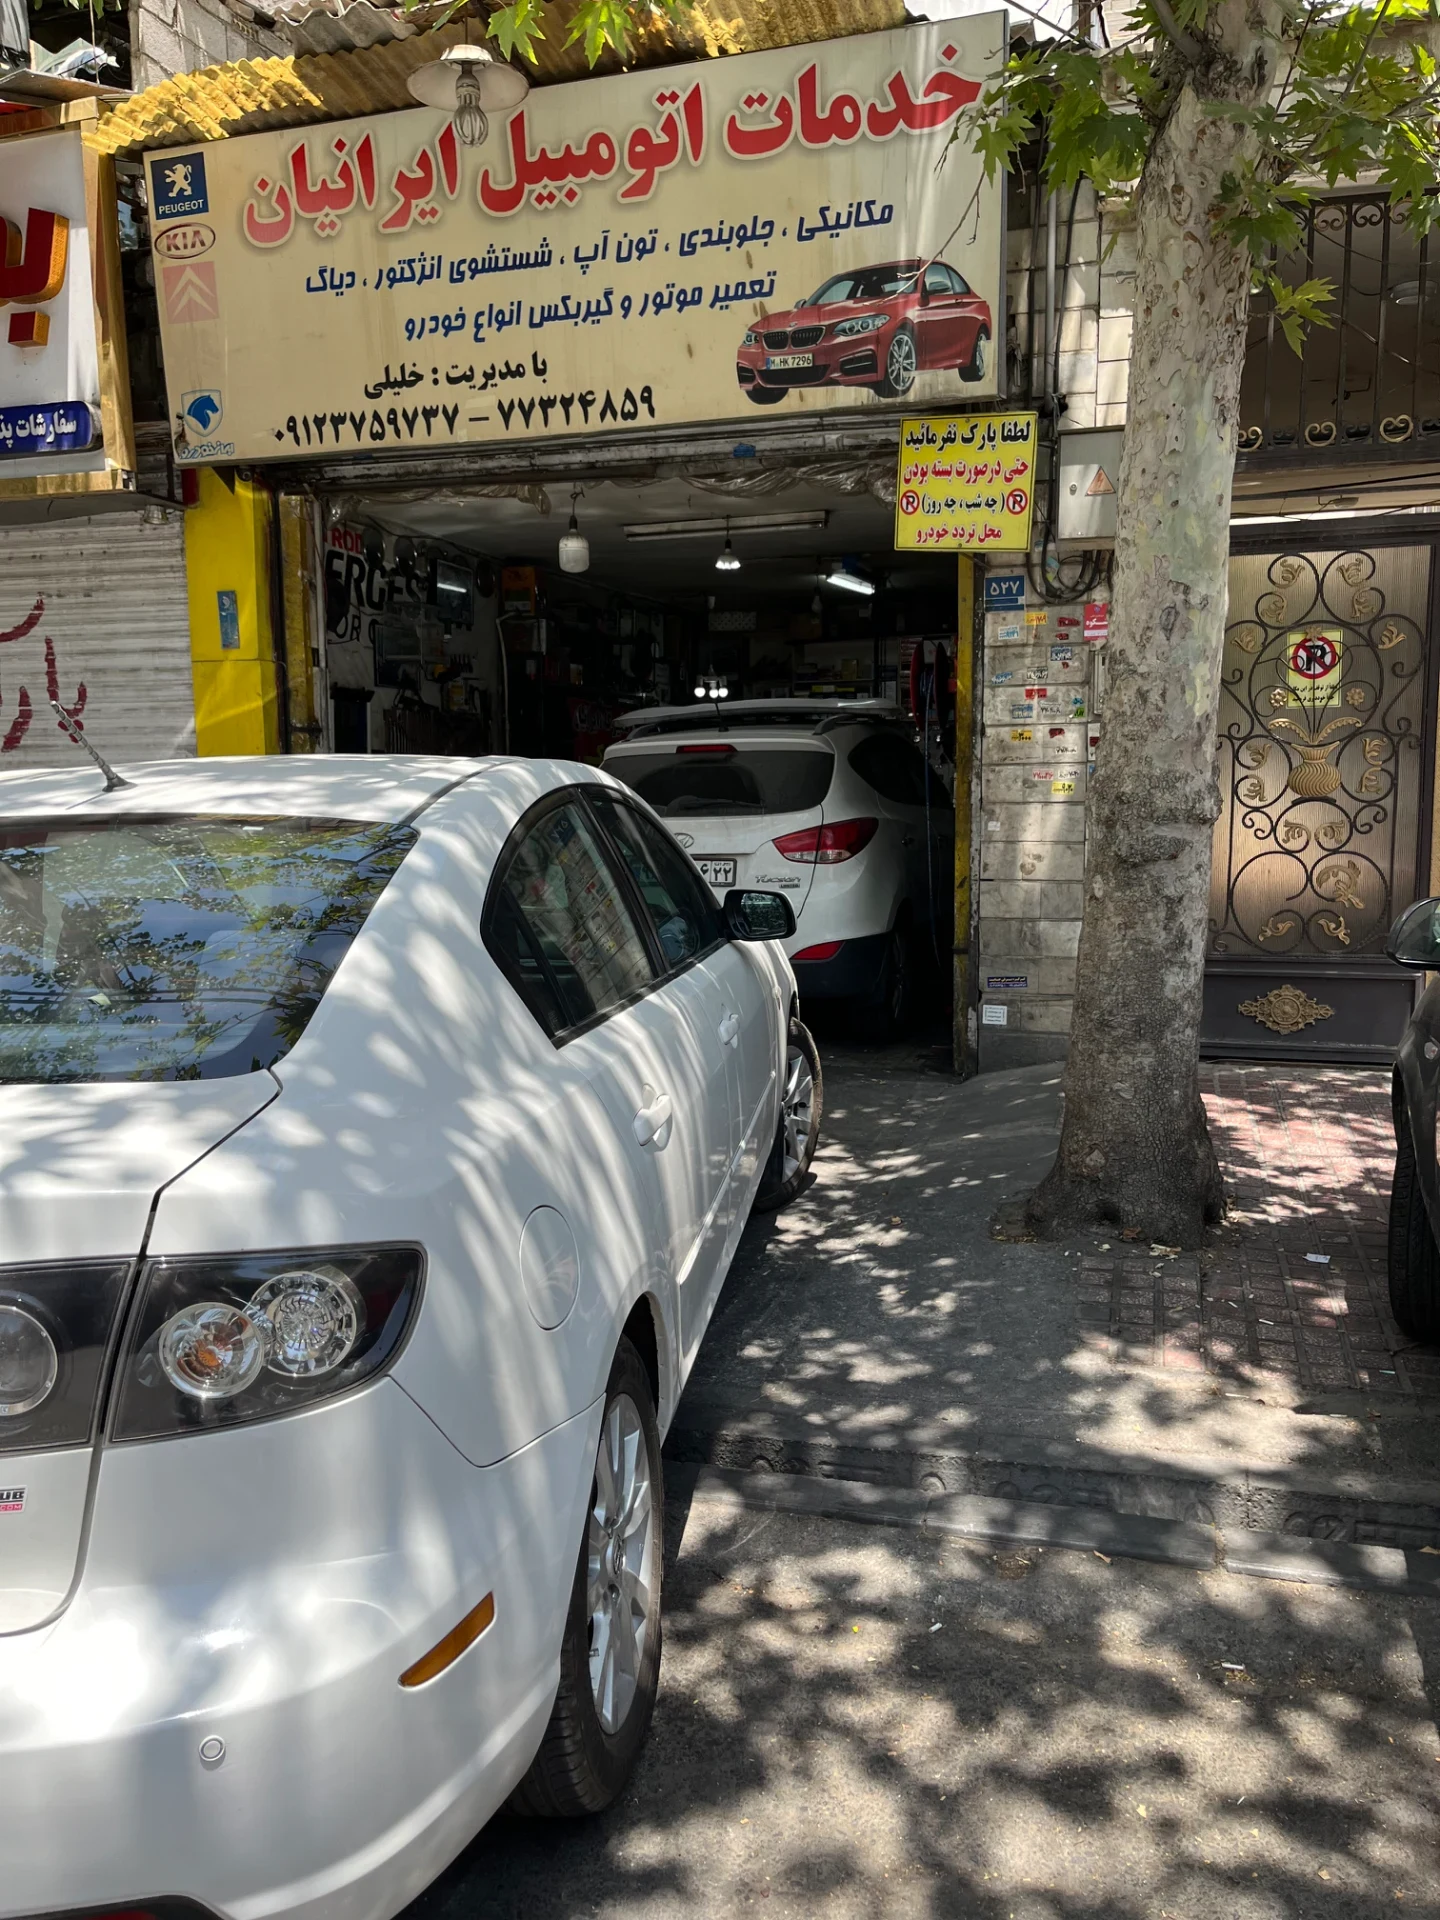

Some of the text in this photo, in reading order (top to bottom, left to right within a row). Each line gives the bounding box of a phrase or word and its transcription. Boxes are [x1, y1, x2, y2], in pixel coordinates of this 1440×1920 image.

[246, 42, 983, 244] خدمات اتومبیل ایرانیان
[158, 199, 205, 216] PEUGEOT
[796, 199, 894, 242] مکانیکی
[164, 232, 207, 253] KIA
[573, 229, 611, 275] آپ
[615, 228, 658, 263] تون
[679, 215, 775, 257] جلوبندی
[374, 251, 443, 290] انژکتور
[449, 236, 553, 284] شستشوی
[305, 265, 356, 297] دیاگ
[404, 270, 778, 343] تعمیر موتور و گیربکس انواع خودرو
[364, 362, 425, 400] خلیلی
[445, 359, 526, 391] مدیریت
[531, 350, 548, 384] با
[15, 409, 77, 443] سفارشات
[274, 402, 459, 447] ۰۹۱۲۳۷۵۹۷۳۷
[497, 385, 655, 431] ۷۷۳۲۴۸۵۹
[1000, 420, 1031, 443] لطفا
[960, 422, 996, 451] پارک
[903, 462, 929, 485] بودن
[931, 460, 953, 482] بسته
[1003, 458, 1029, 483] حتی
[916, 523, 1002, 544] محل تردد خودرو
[990, 580, 1020, 596] ۵۲۷
